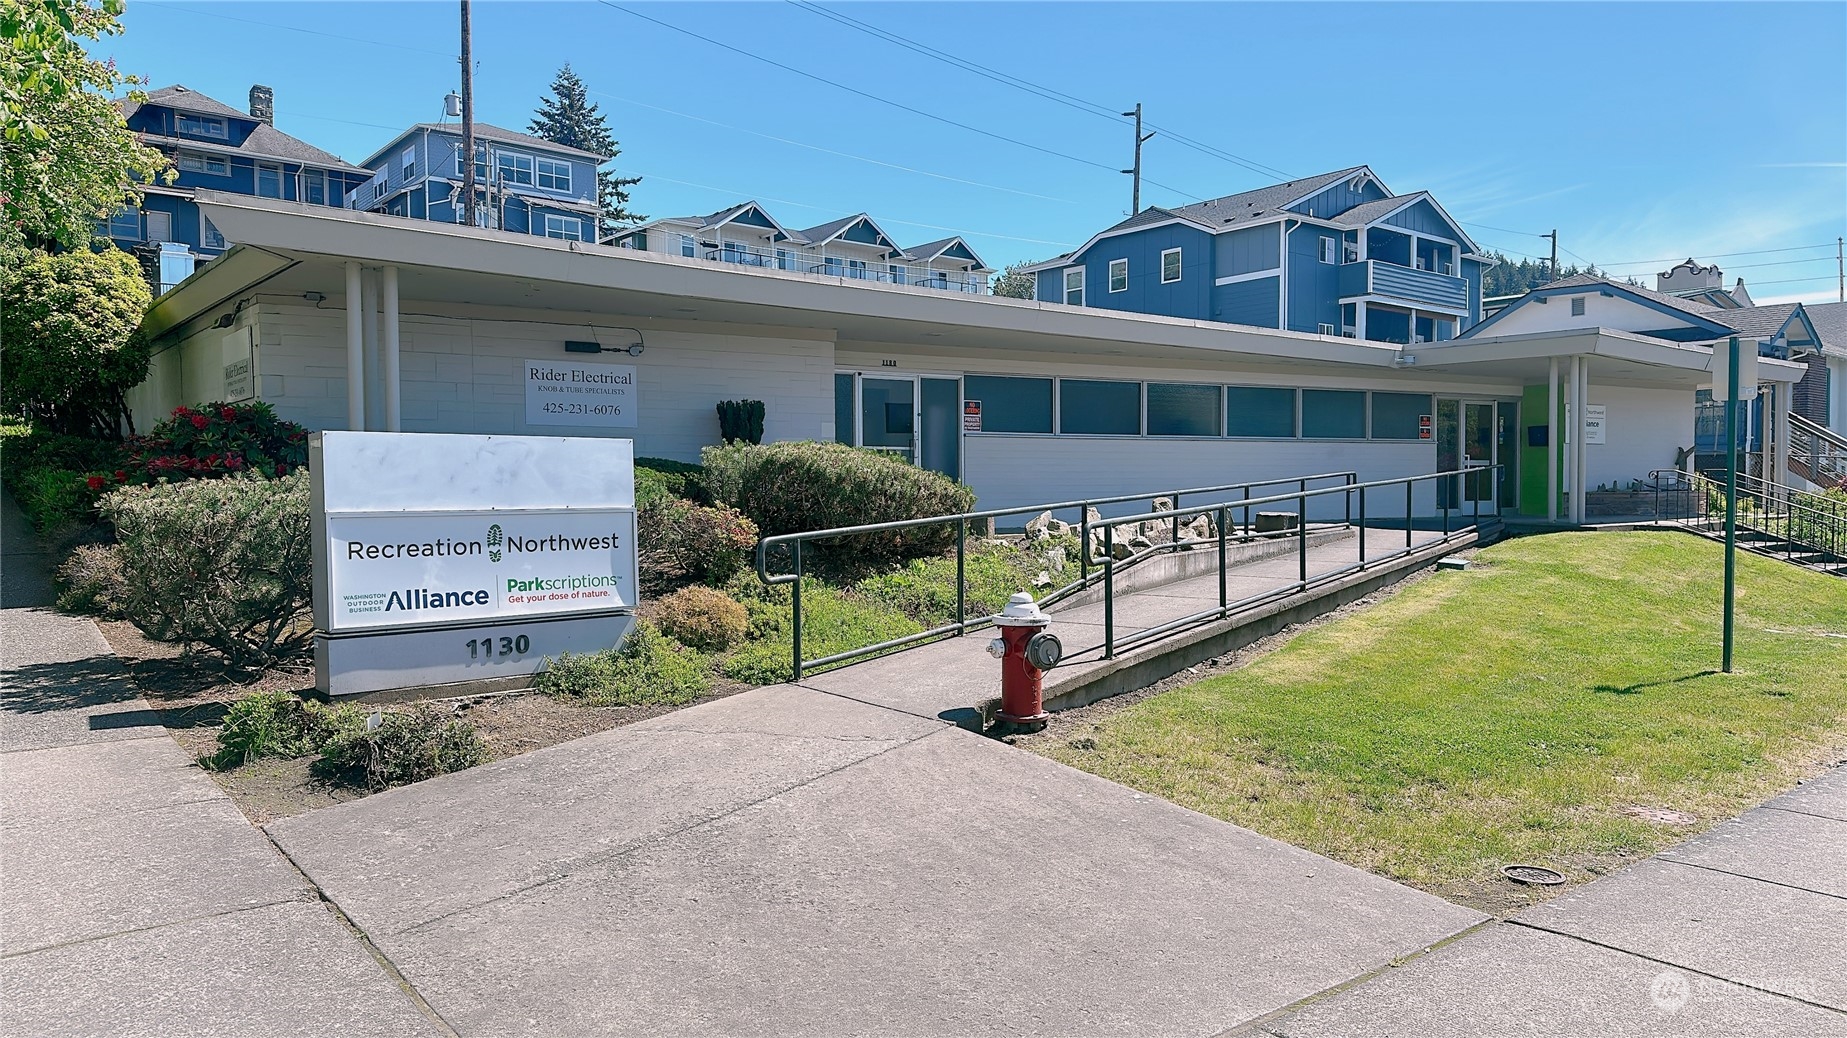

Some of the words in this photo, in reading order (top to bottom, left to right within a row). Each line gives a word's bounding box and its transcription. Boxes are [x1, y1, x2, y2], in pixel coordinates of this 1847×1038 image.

[530, 368, 567, 381] Rider
[571, 370, 632, 384] Electrical
[543, 403, 621, 415] 425-231-6076
[348, 538, 482, 560] Recreation
[507, 533, 619, 553] Northwest
[385, 589, 489, 611] Alliance
[508, 595, 524, 603] Get
[526, 594, 546, 603] your
[548, 592, 569, 600] dose
[571, 591, 579, 599] of
[582, 590, 611, 598] nature.
[466, 635, 530, 659] 1130
